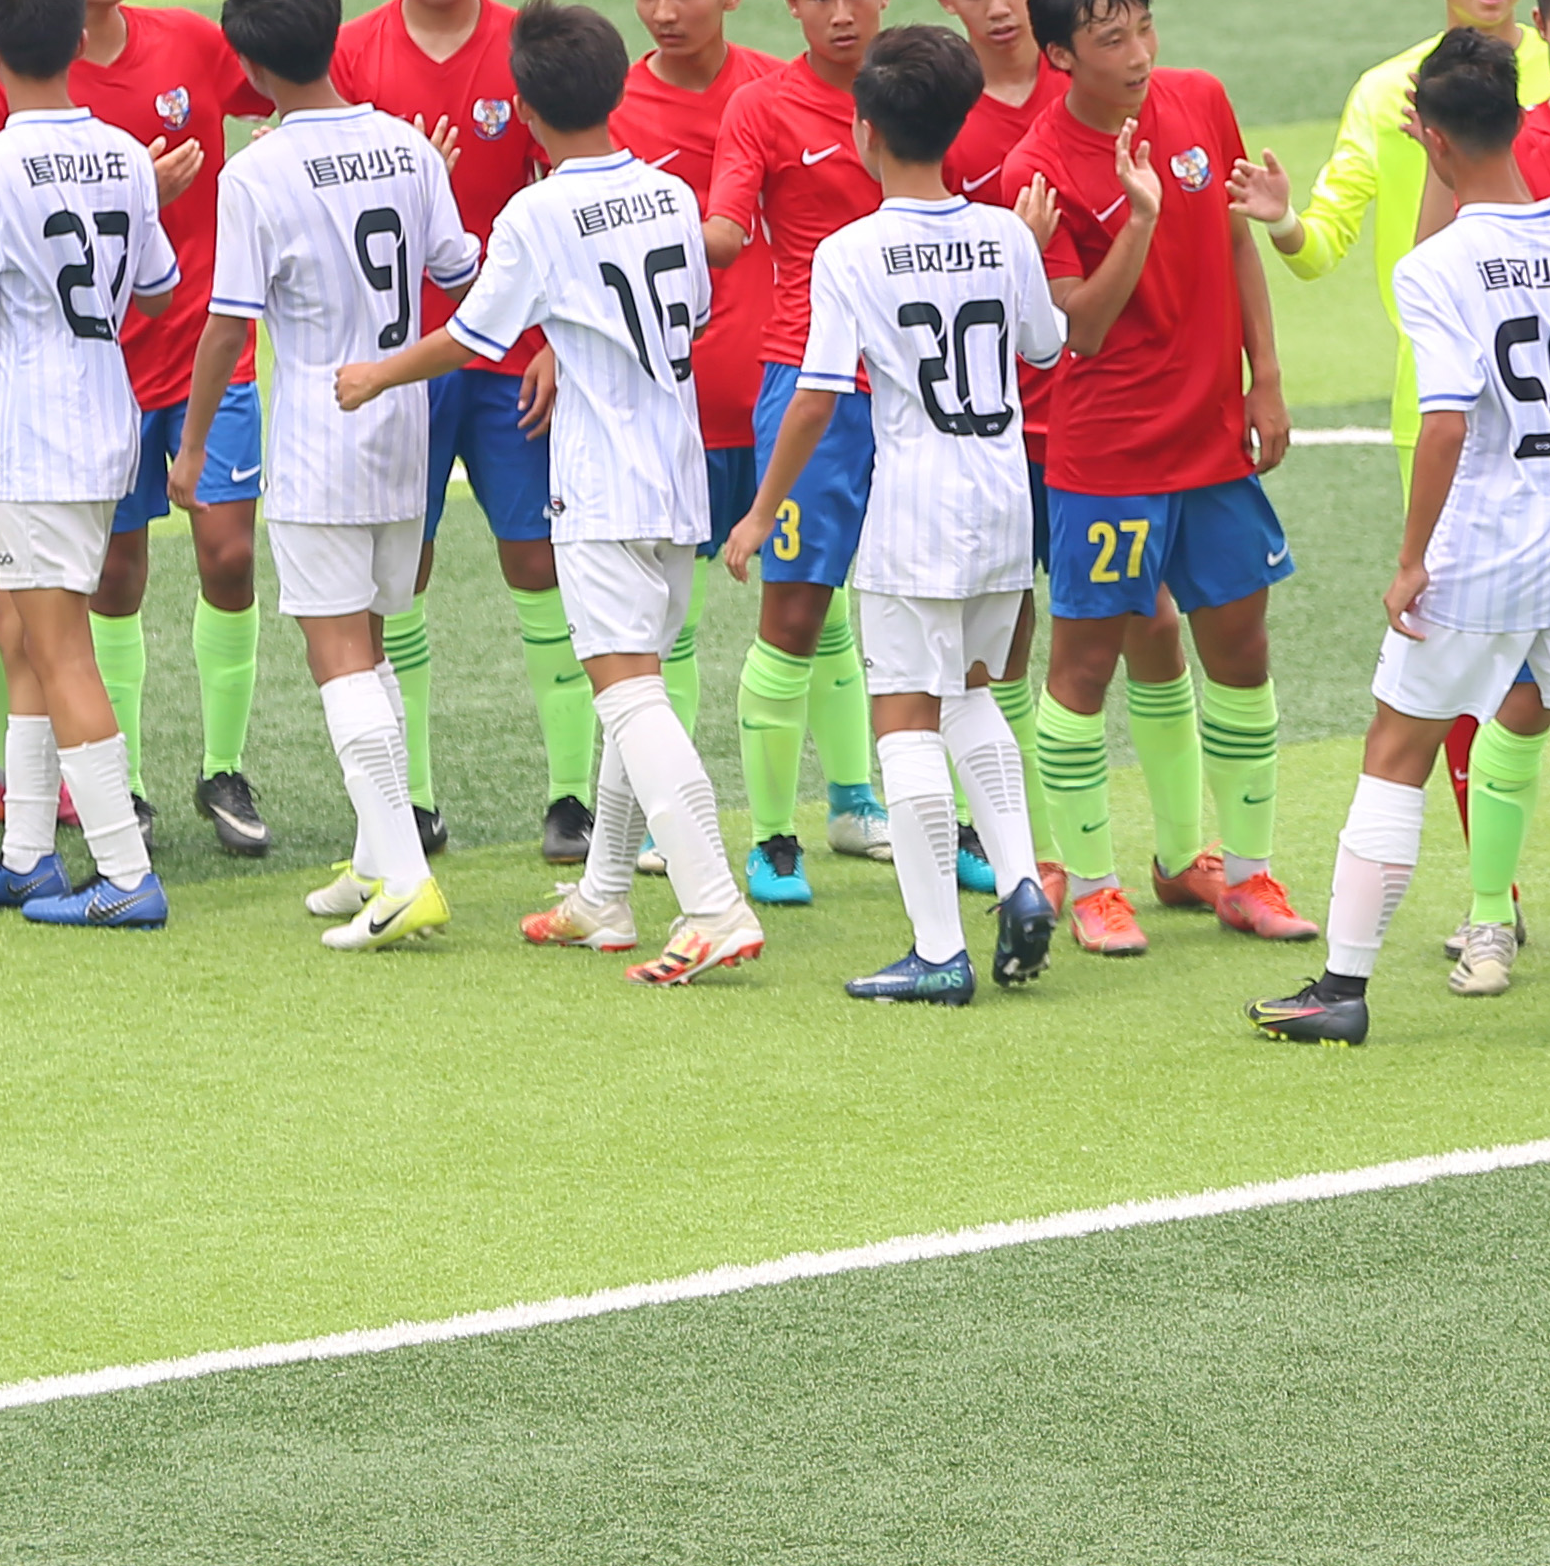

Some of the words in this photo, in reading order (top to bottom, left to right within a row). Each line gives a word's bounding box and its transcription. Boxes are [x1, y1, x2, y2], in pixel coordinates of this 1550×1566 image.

[22, 152, 130, 188] 追风少年
[303, 146, 417, 189] 追风少年
[572, 189, 680, 238] 追风少年
[43, 210, 130, 346] 27
[354, 207, 411, 350] 9
[881, 240, 1005, 276] 追风少年
[599, 244, 692, 382] 16
[898, 300, 1014, 437] 20
[773, 499, 801, 561] 3
[1087, 519, 1150, 583] 27
